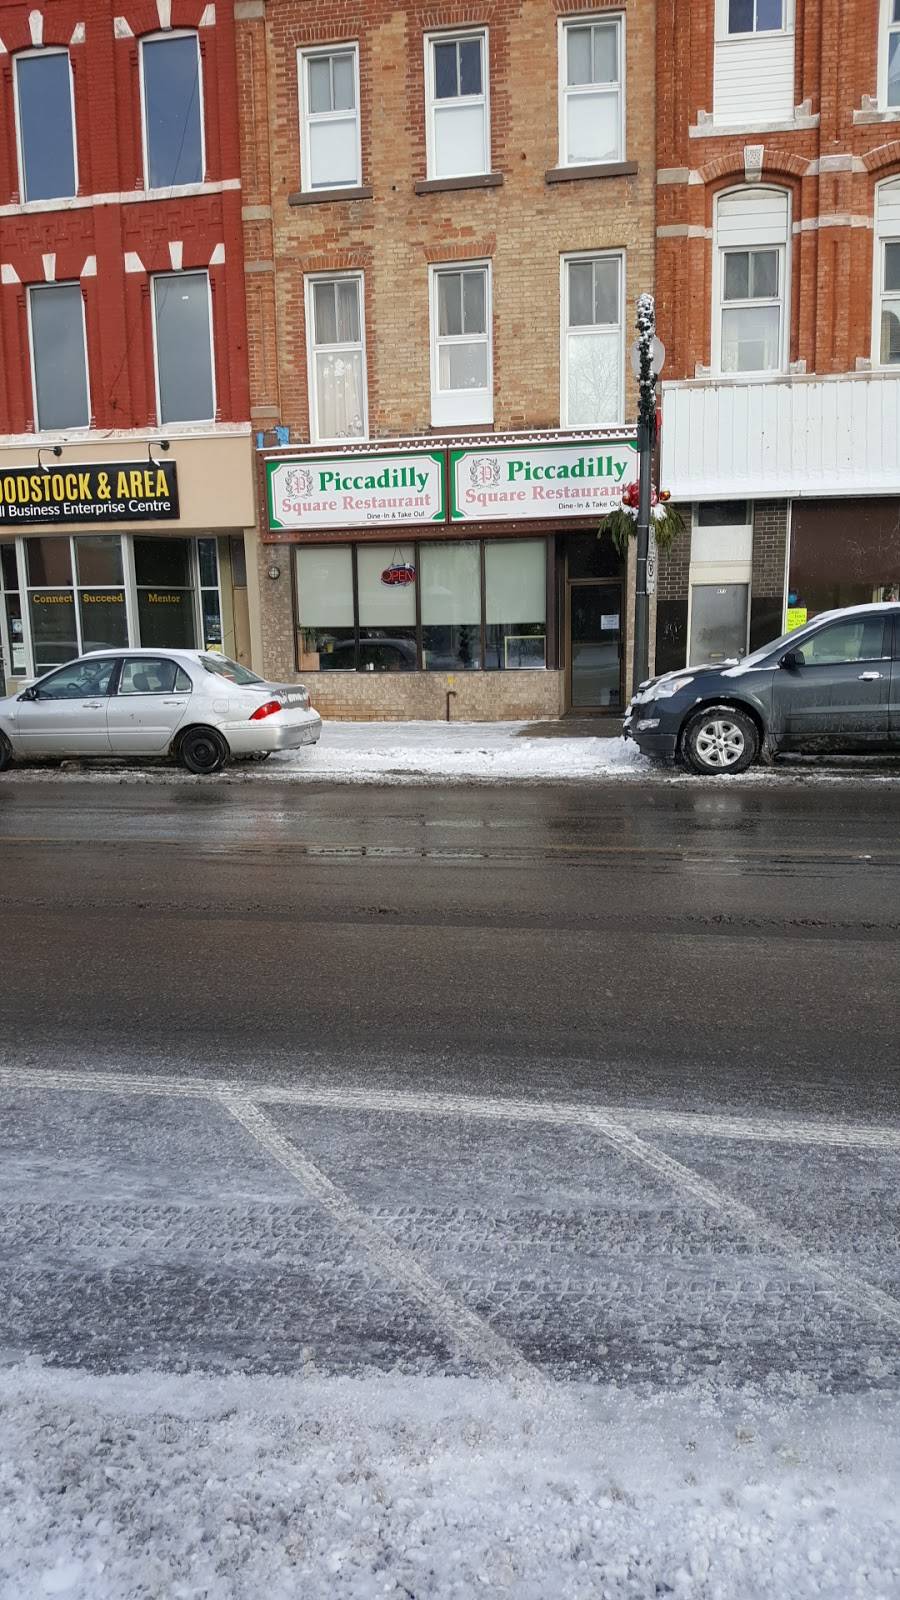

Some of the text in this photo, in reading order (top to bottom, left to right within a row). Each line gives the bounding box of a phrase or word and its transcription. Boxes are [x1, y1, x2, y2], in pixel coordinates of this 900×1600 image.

[507, 455, 628, 482] Piccadilly
[0, 469, 170, 504] ODSTOCK & AREA
[319, 466, 430, 493] Piccadilly
[282, 493, 432, 517] Square Restaurant
[465, 484, 625, 507] Square Restauran
[8, 503, 61, 517] Business
[64, 500, 125, 517] Enterprise
[129, 499, 171, 512] Centre
[367, 512, 390, 520] Dine-In
[414, 510, 425, 518] Out
[558, 502, 584, 510] Dine-In
[381, 569, 416, 583] OPEN
[33, 593, 181, 604] Connect Succeed Mentor
